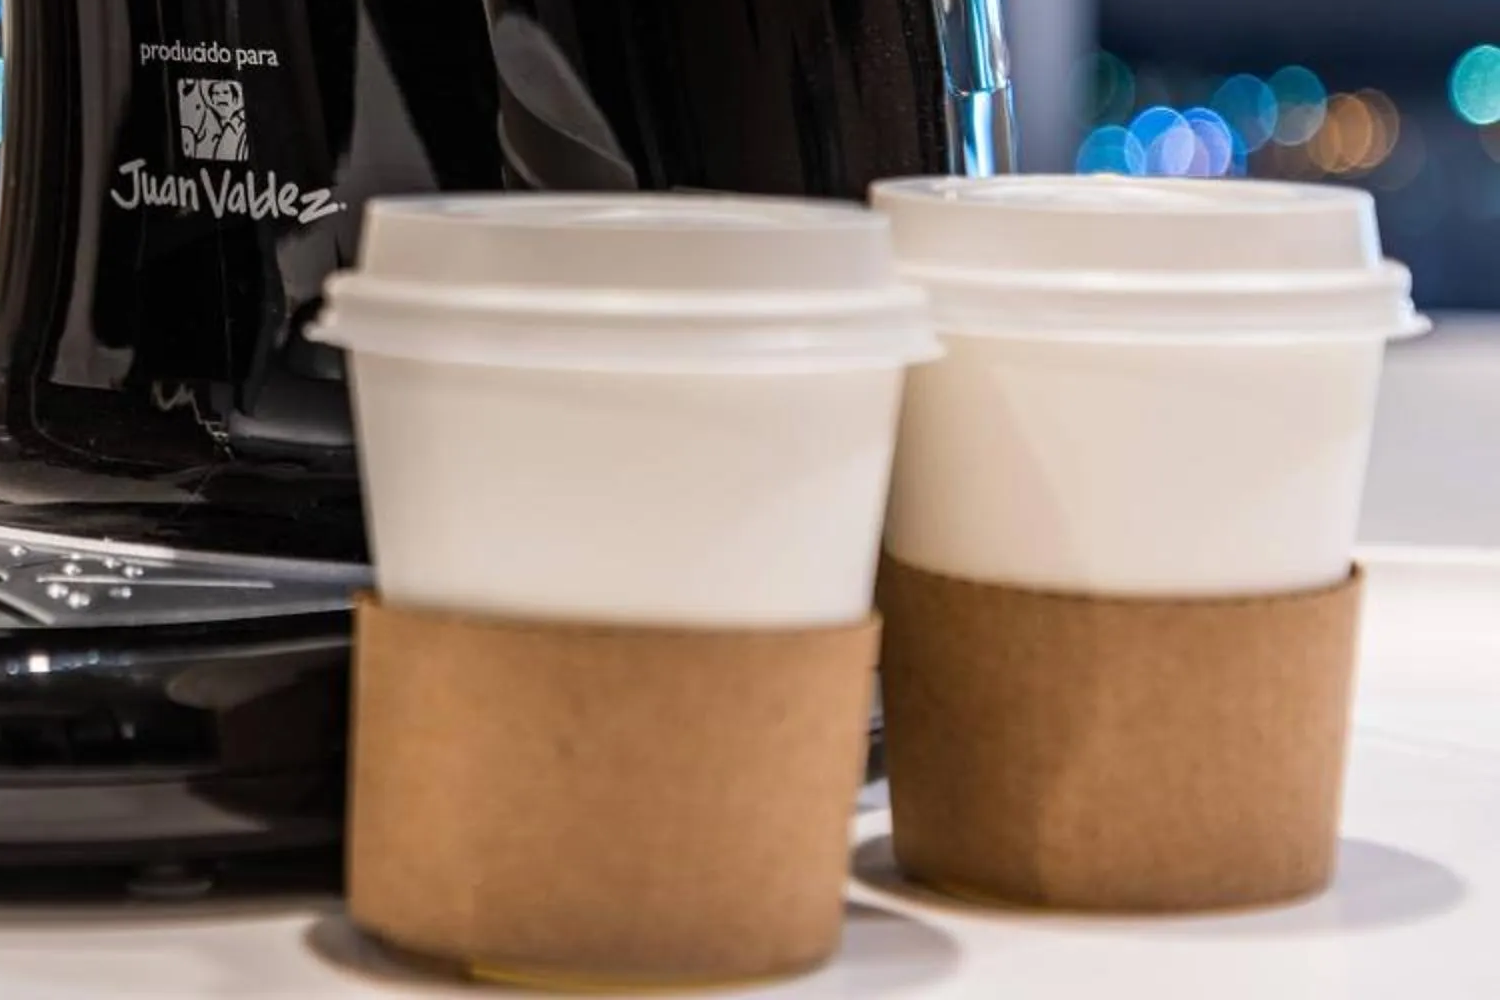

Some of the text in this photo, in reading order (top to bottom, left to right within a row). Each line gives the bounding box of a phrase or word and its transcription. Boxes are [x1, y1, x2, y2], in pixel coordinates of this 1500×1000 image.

[140, 40, 279, 70] producido para
[111, 158, 340, 224] Juan Valdez
